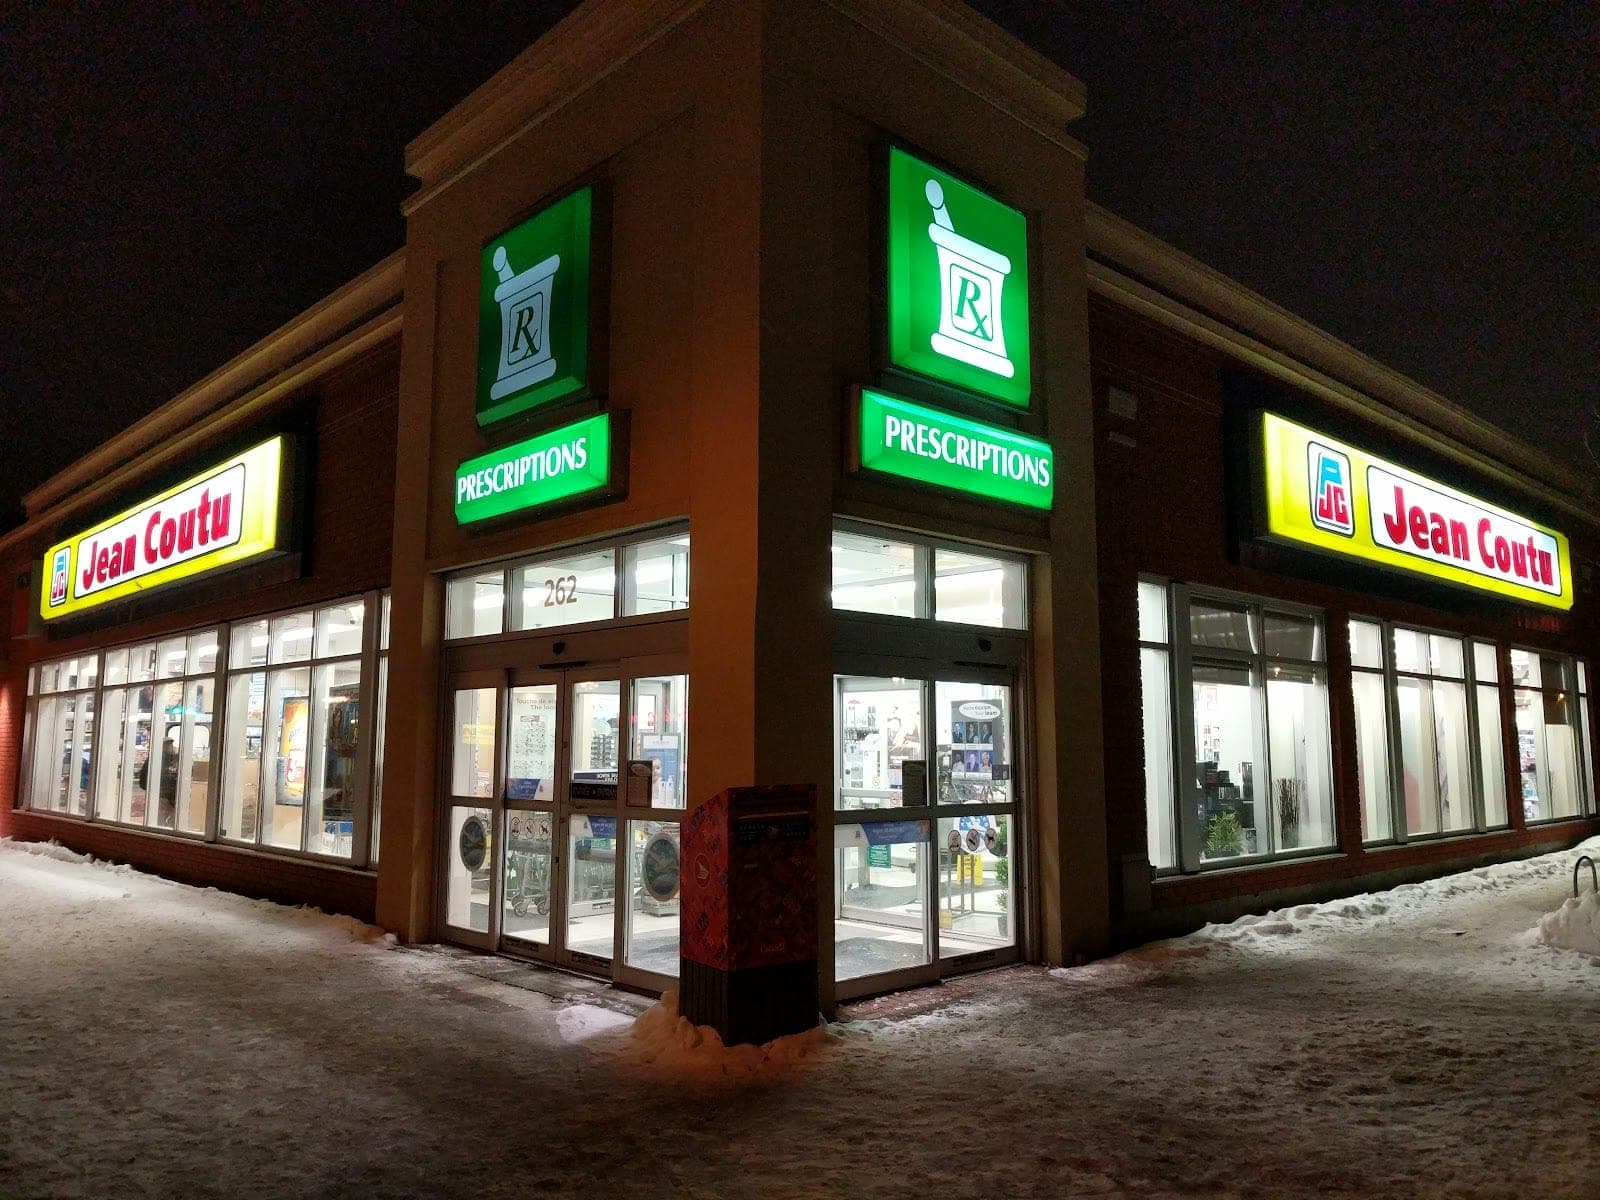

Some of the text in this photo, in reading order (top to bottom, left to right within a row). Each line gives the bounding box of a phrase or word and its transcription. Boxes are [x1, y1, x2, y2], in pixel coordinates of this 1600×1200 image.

[456, 437, 588, 505] PRESCRIPTIONS
[884, 415, 1050, 488] PRESCRIPTIONS
[82, 487, 233, 590] Jean Coutu
[1383, 485, 1555, 586] Jean Coutu
[543, 575, 578, 608] 262
